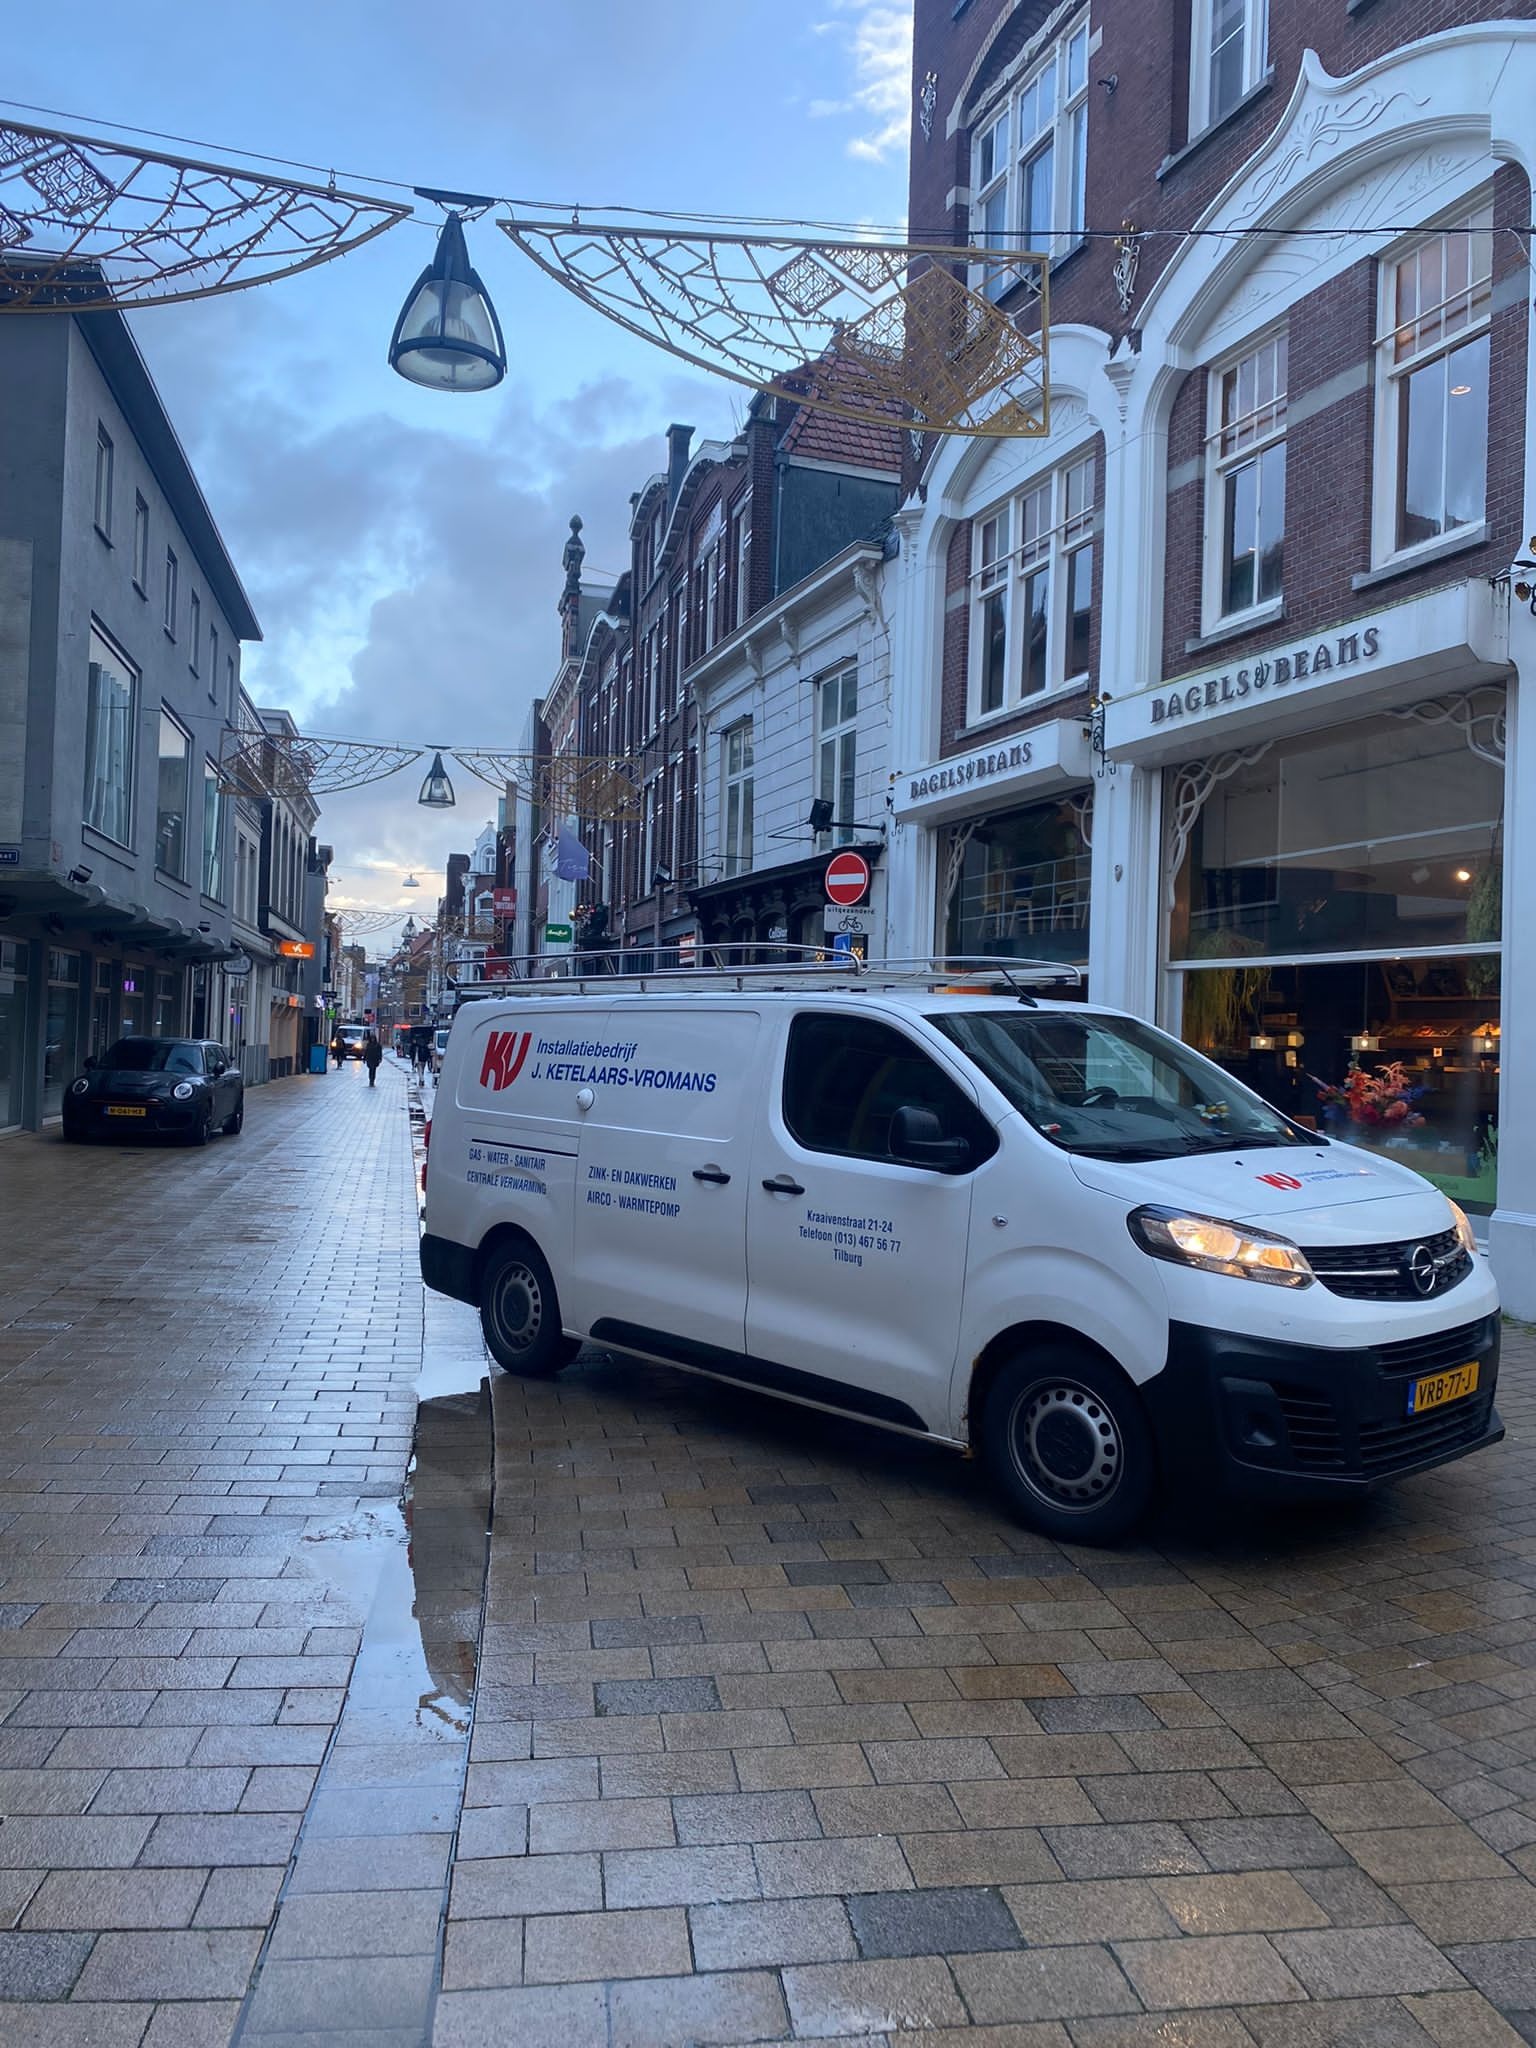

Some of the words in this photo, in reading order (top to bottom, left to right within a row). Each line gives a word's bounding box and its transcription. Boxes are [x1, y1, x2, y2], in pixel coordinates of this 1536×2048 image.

[536, 1039, 638, 1062] Installatiebedrijf
[531, 1062, 542, 1080] J.
[546, 1063, 717, 1093] KETELAARS-VROMANS
[469, 1148, 482, 1161] GAS
[487, 1151, 509, 1165] WATER
[514, 1155, 546, 1170] SANITAIR
[467, 1171, 499, 1186] CENTRALE
[500, 1175, 547, 1195] VERWARMING
[588, 1166, 610, 1181] ZINK-
[611, 1168, 622, 1183] EN
[624, 1171, 676, 1191] DAKWERKEN
[587, 1190, 611, 1206] AIRCO
[618, 1196, 681, 1217] WARMTEPOMP
[807, 1209, 866, 1230] Kraaivenstraat
[868, 1218, 893, 1233] 21-24
[799, 1226, 832, 1241] Telefoon
[834, 1232, 857, 1248] (013)
[859, 1236, 874, 1249] 467
[876, 1238, 888, 1251] 56
[890, 1240, 901, 1253] 77
[834, 1248, 863, 1267] Tilburg
[1419, 1368, 1472, 1405] VRB-77-J
